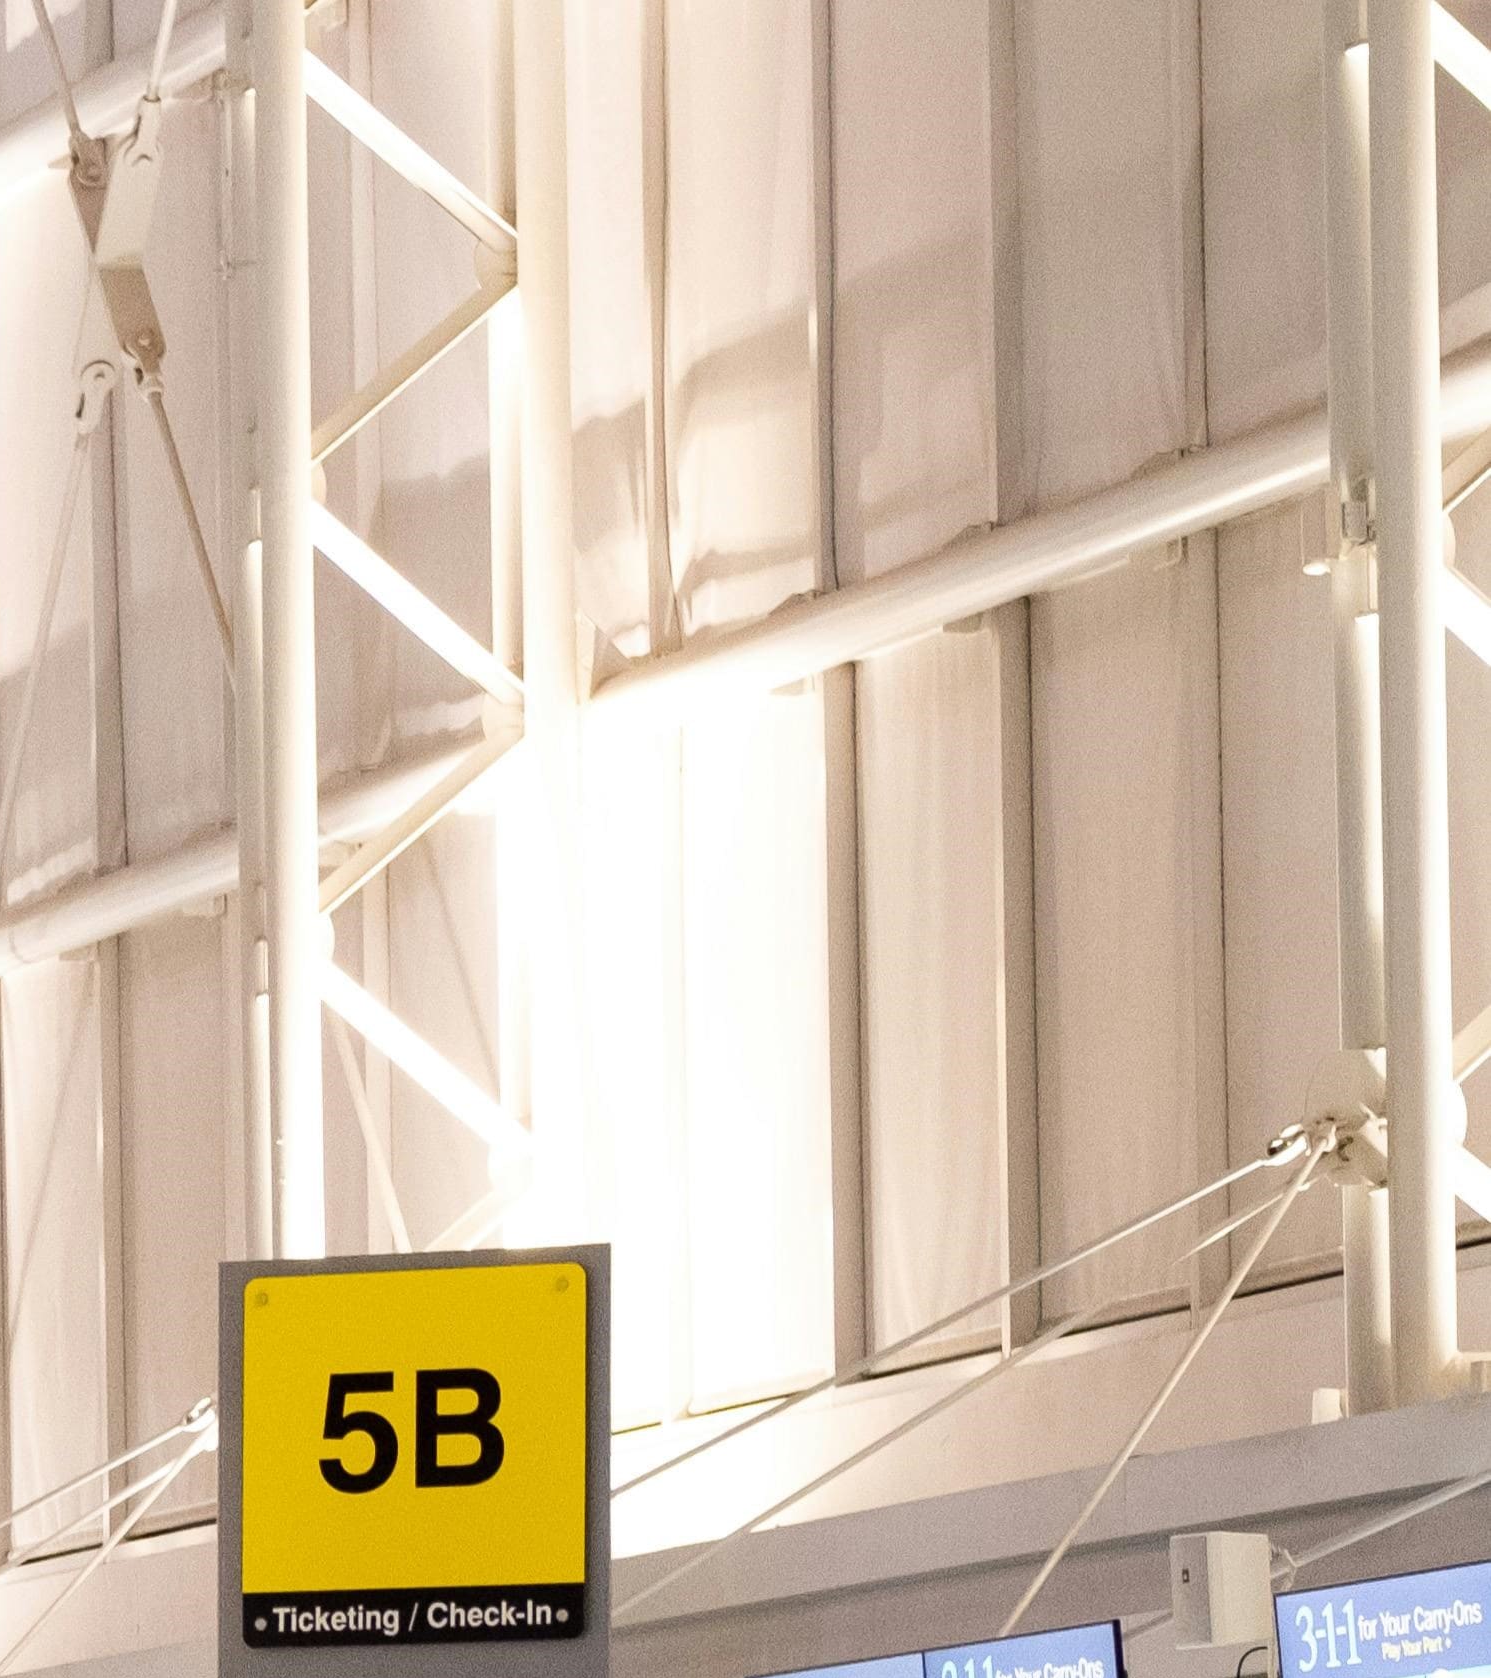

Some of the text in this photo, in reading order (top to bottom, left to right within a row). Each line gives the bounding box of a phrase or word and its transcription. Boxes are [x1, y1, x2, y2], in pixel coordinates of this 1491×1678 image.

[319, 1367, 505, 1495] 5B
[272, 1600, 553, 1636] Ticketing / Check-In
[1295, 1599, 1482, 1672] 3-1-1 for Your Carry-Ons
